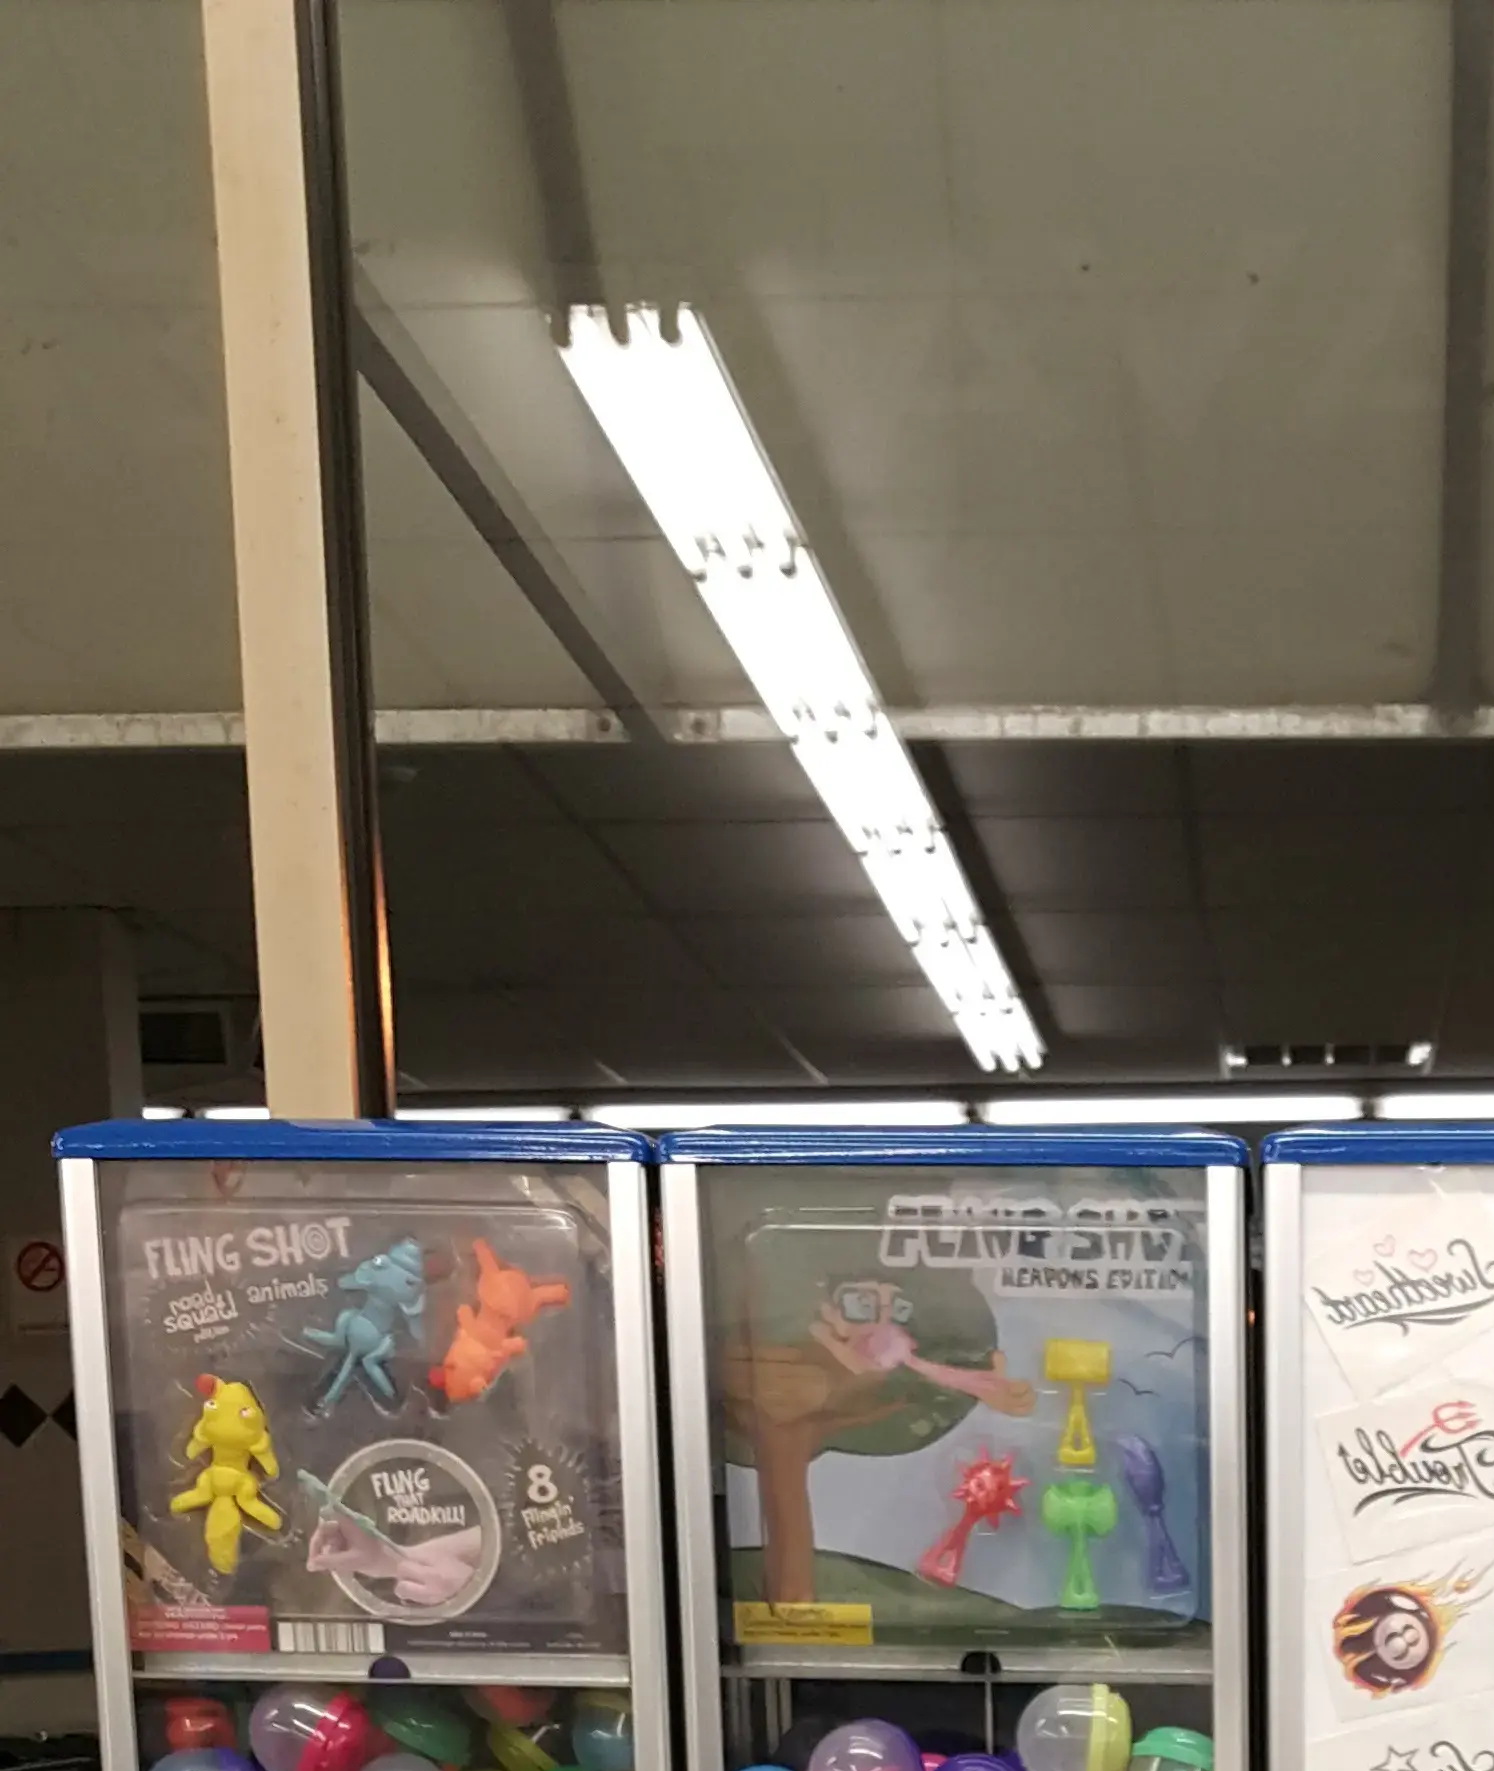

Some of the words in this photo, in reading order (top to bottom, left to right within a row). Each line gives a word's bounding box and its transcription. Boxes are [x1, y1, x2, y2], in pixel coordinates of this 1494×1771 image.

[145, 1233, 241, 1279] FLING
[246, 1216, 352, 1267] SHOT
[246, 1272, 329, 1304] animals
[370, 1467, 431, 1498] FLING
[527, 1463, 559, 1503] 8
